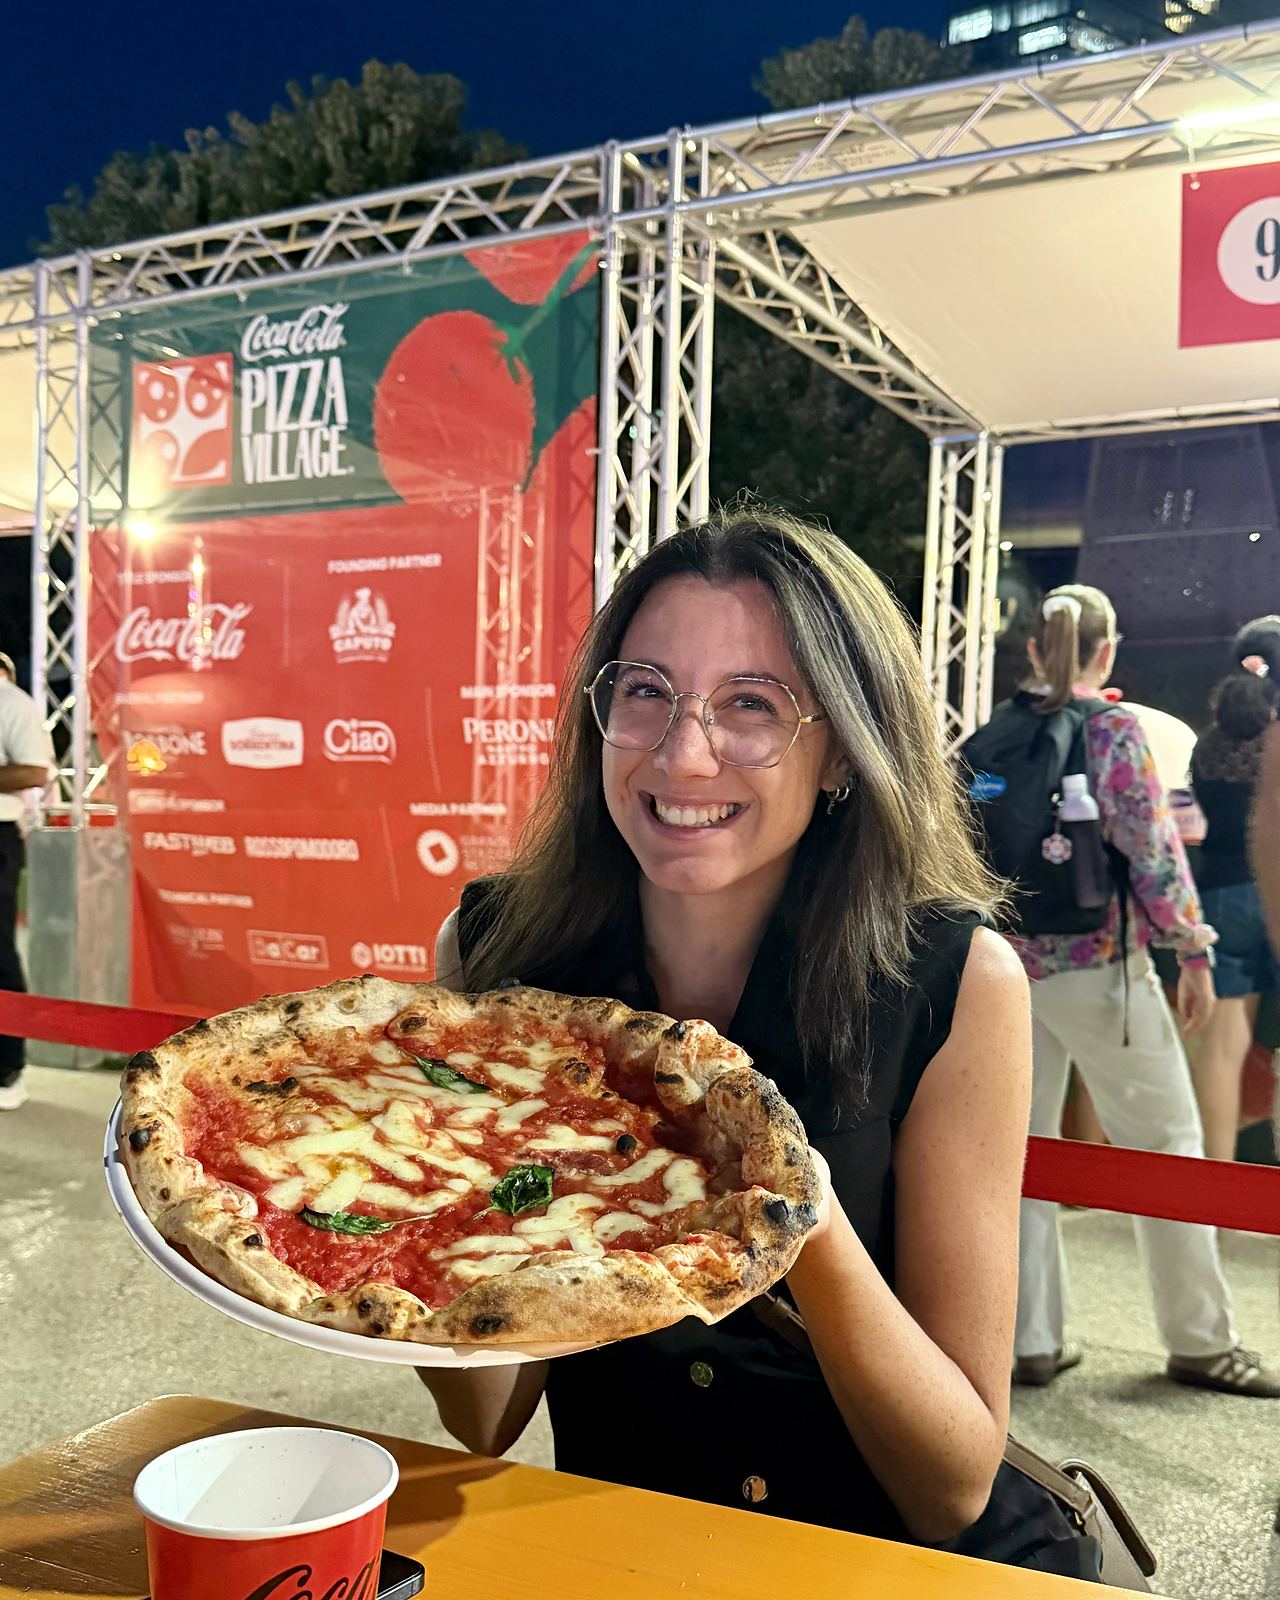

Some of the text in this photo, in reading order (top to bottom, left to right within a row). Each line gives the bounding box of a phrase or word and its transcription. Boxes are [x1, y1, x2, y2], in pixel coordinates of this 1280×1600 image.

[1255, 218, 1280, 282] 9
[241, 356, 348, 435] PIZZA
[241, 424, 349, 485] VILLAGE
[327, 552, 442, 574] FOUNDING PARTNER
[333, 635, 392, 653] CAPUTO
[324, 718, 389, 754] Ciao
[409, 803, 448, 816] MEDIA
[243, 1555, 378, 1600] Cca
